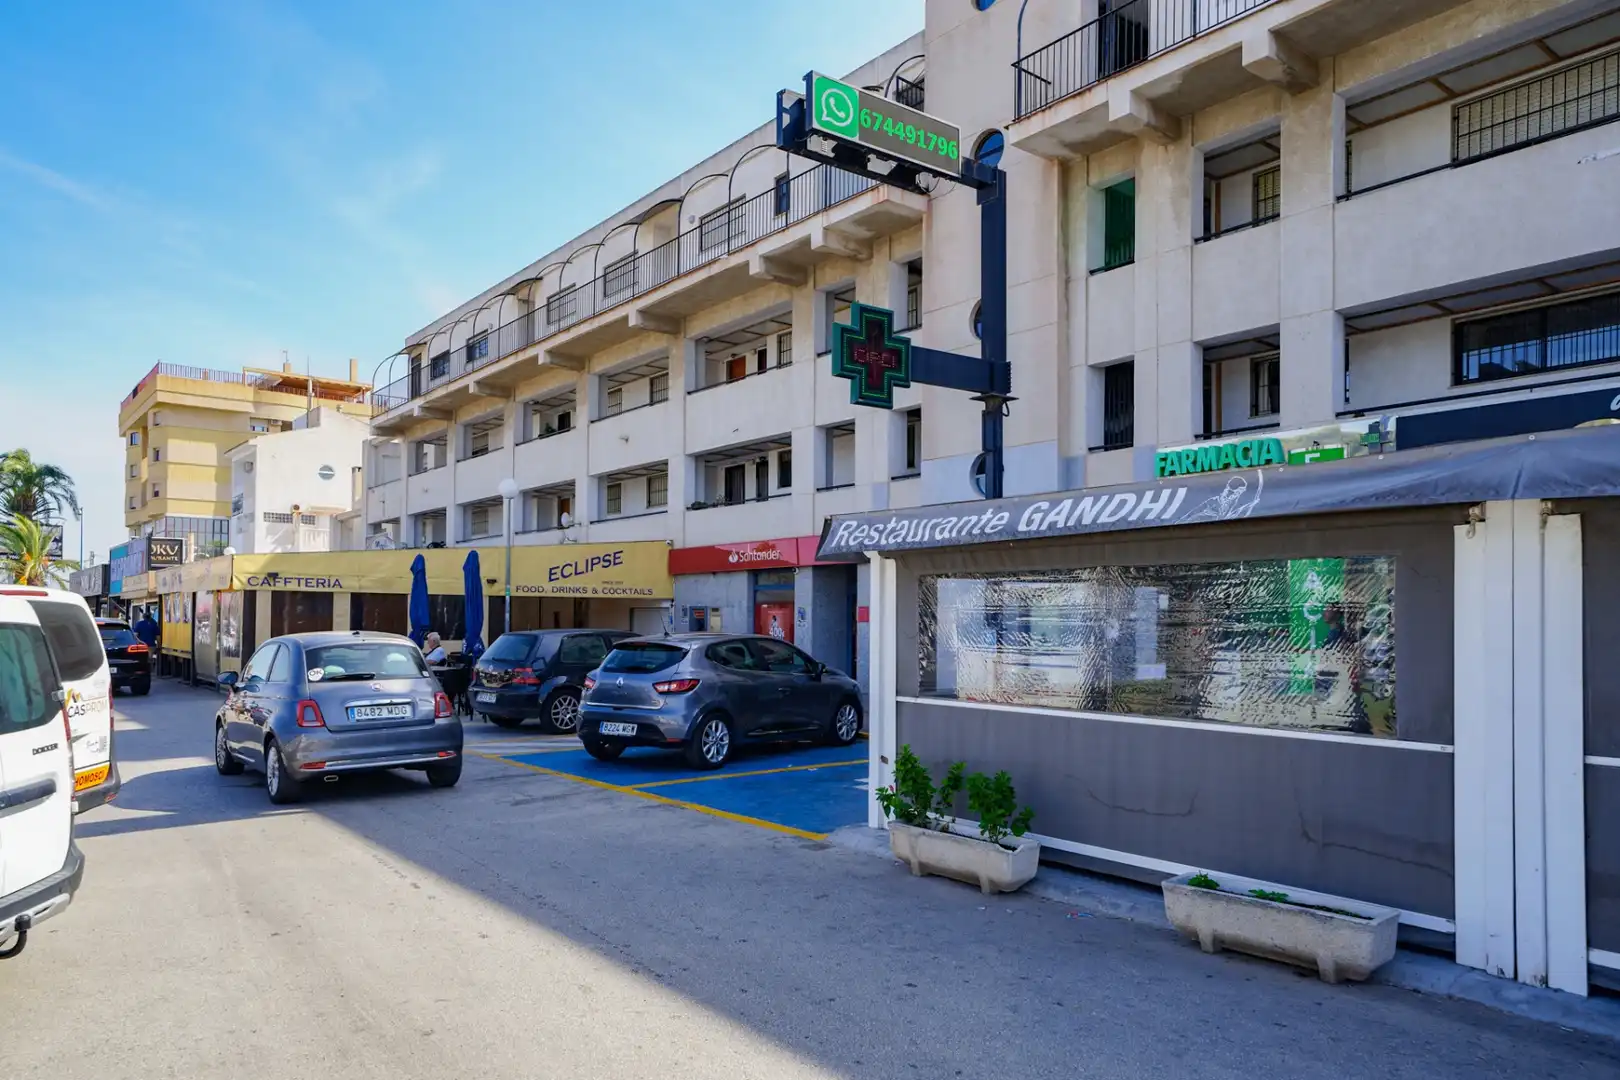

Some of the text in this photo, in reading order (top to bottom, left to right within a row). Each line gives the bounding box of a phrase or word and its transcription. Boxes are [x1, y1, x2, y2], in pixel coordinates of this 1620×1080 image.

[860, 108, 958, 160] 674491796
[1155, 437, 1285, 478] FARMACIA
[831, 487, 1188, 547] Restaurante GANDHI
[548, 550, 624, 582] ECLIPSE
[739, 548, 780, 562] Santander
[515, 585, 547, 594] FOOD,
[551, 586, 588, 594] DRINKS
[601, 587, 653, 596] COCKTAILS
[356, 706, 408, 717] 8482 MDG
